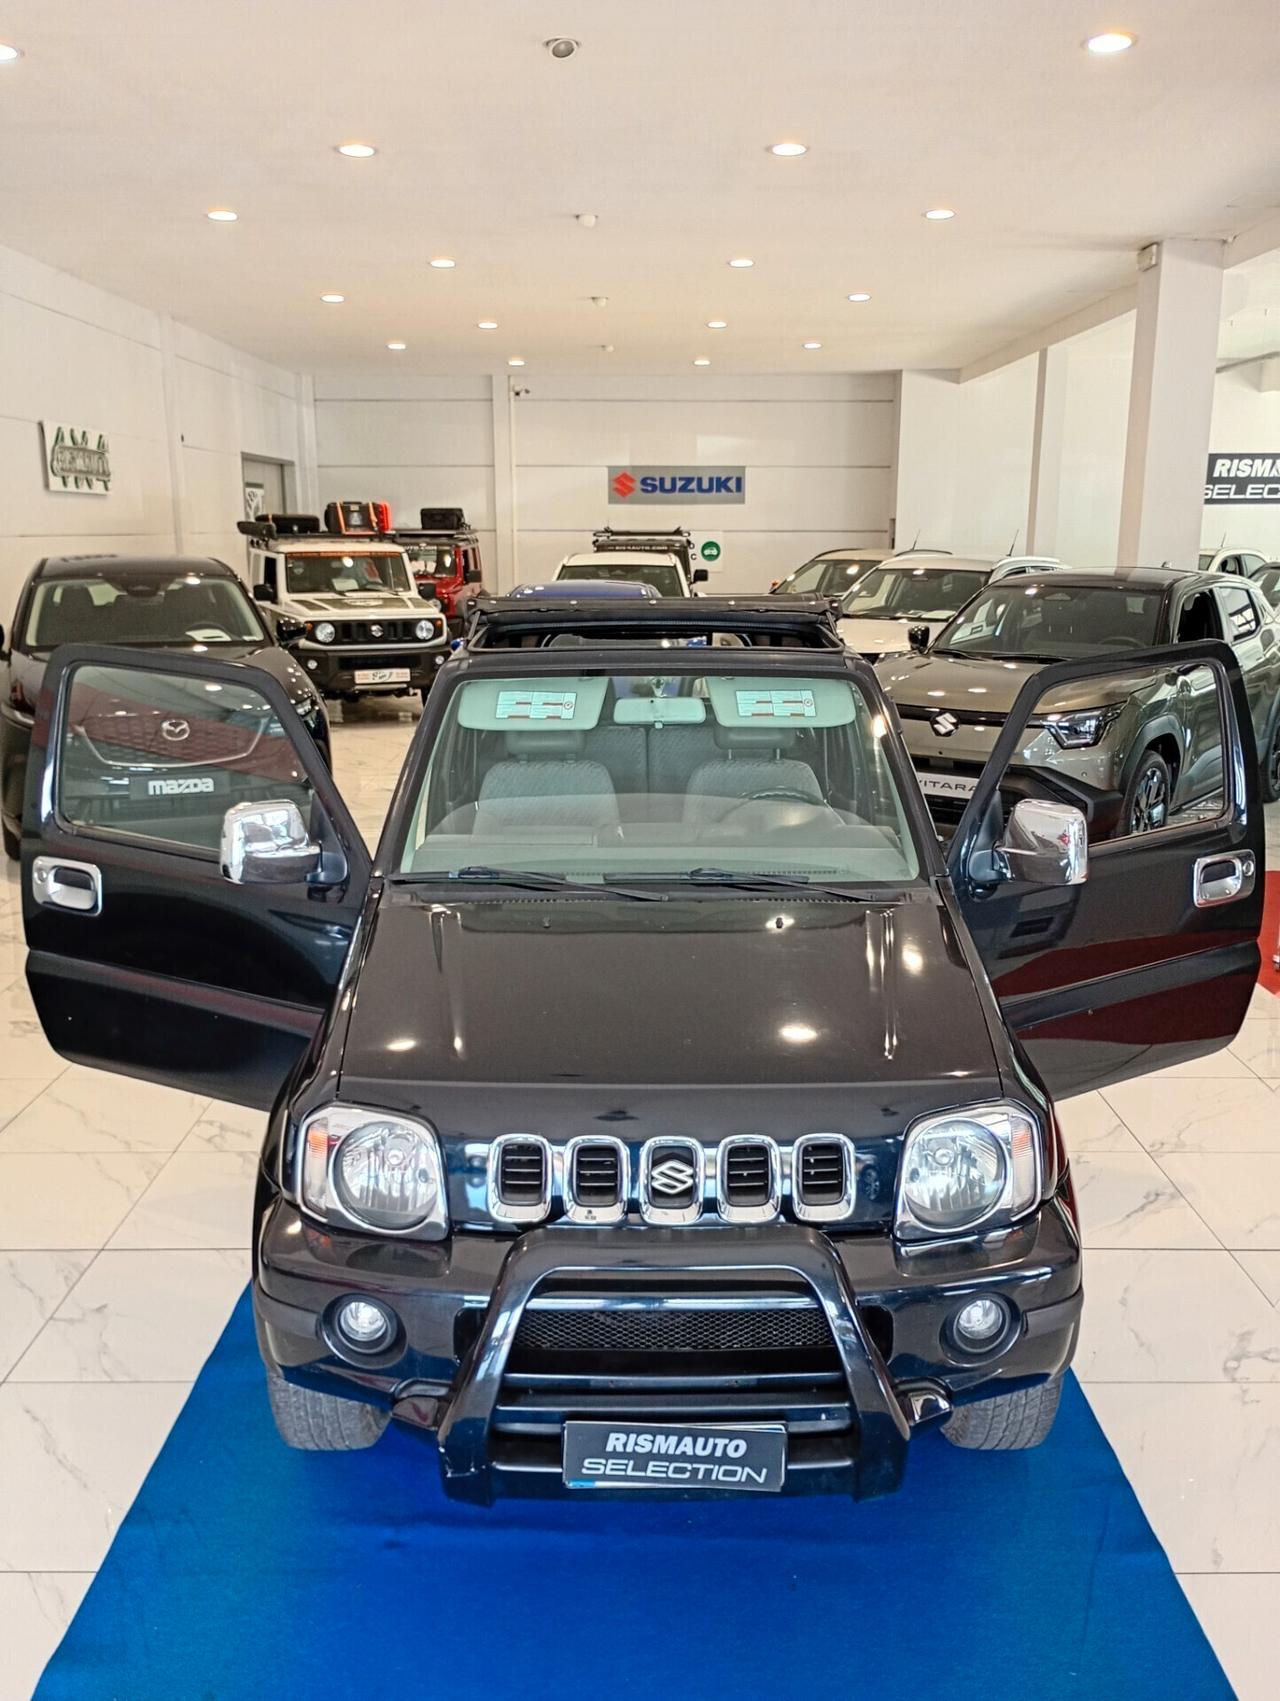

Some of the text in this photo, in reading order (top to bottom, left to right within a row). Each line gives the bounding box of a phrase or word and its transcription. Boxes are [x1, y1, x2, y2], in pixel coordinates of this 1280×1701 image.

[640, 476, 742, 494] SUZUKI
[148, 778, 214, 795] mazda
[919, 780, 977, 792] ITARA
[606, 1432, 748, 1458] RISMAUTO
[581, 1458, 768, 1484] SELECTION
